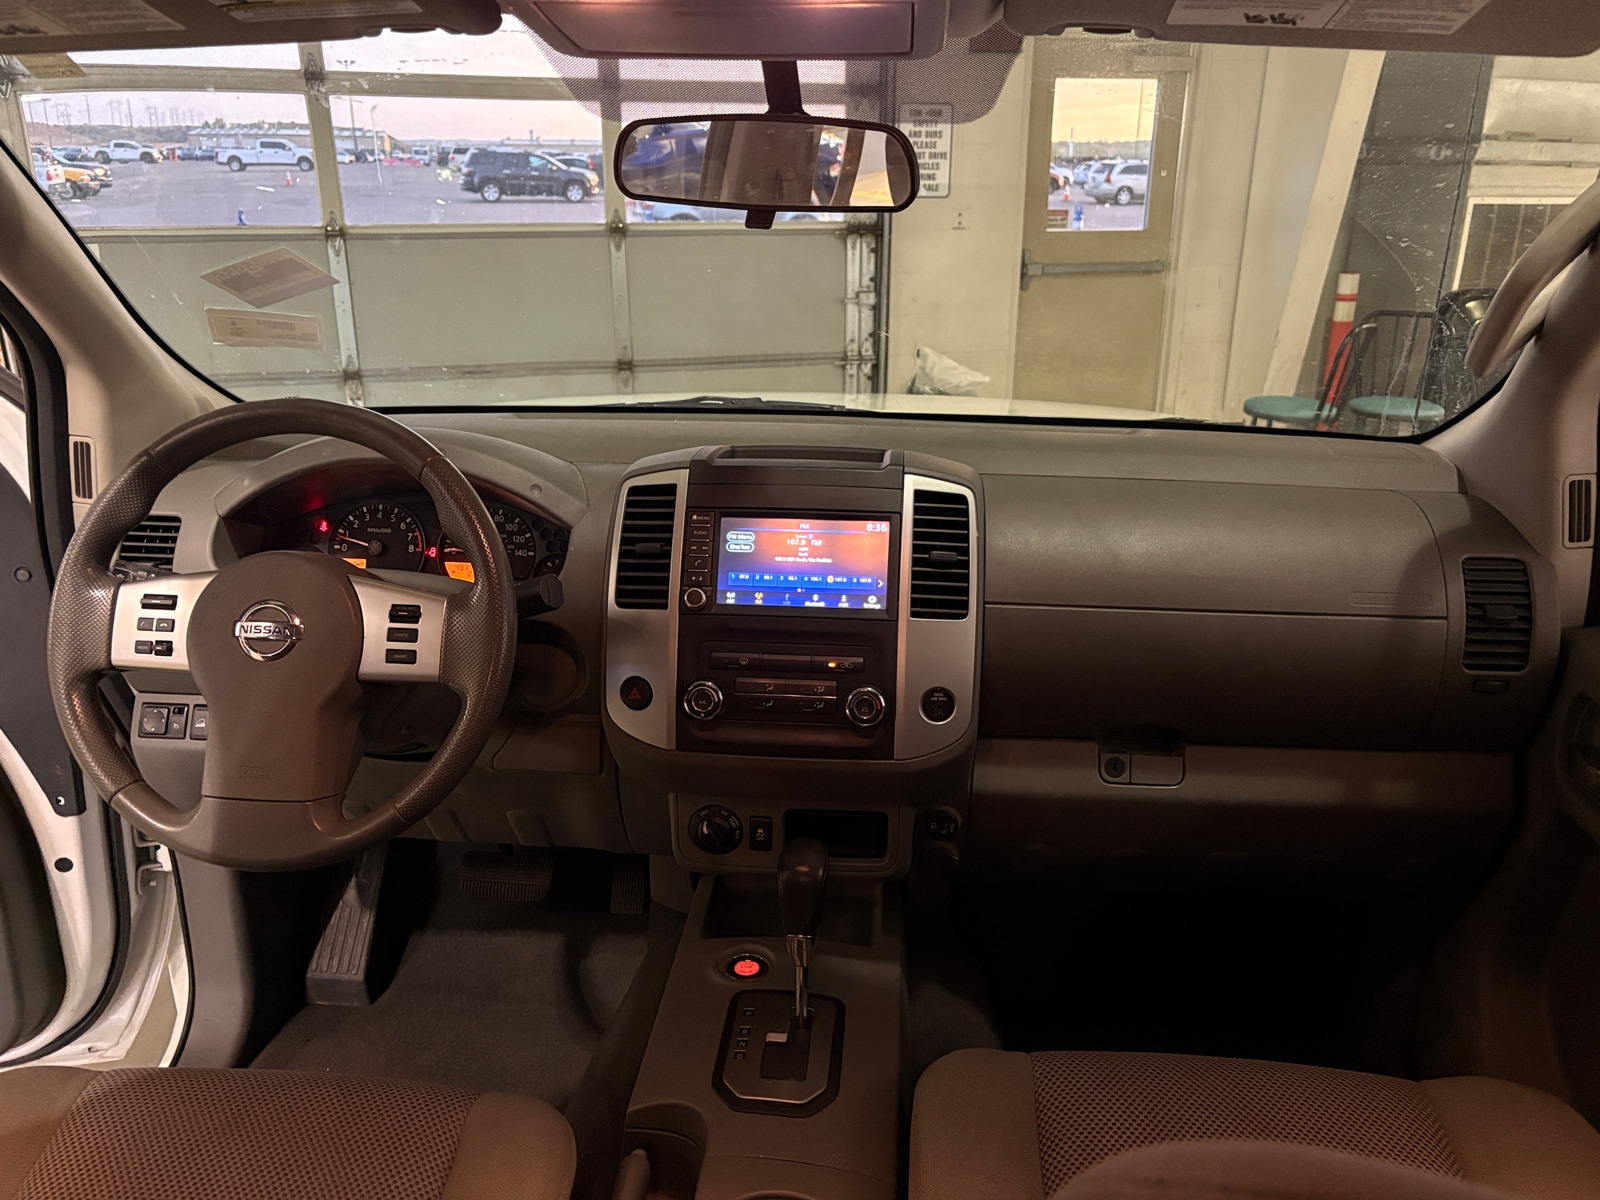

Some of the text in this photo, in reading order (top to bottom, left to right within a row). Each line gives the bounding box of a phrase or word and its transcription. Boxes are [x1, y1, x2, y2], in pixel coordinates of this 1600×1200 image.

[909, 130, 922, 138] AND
[913, 141, 937, 149] PLEASE
[928, 152, 947, 160] DRIVE
[364, 514, 370, 522] 3
[390, 514, 396, 522] 5
[353, 520, 359, 528] 2
[400, 522, 406, 530] 6
[866, 524, 887, 532] 8:36
[407, 533, 412, 541] 7
[408, 544, 414, 552] 8
[515, 549, 527, 557] 140
[240, 625, 294, 636] NISSAN
